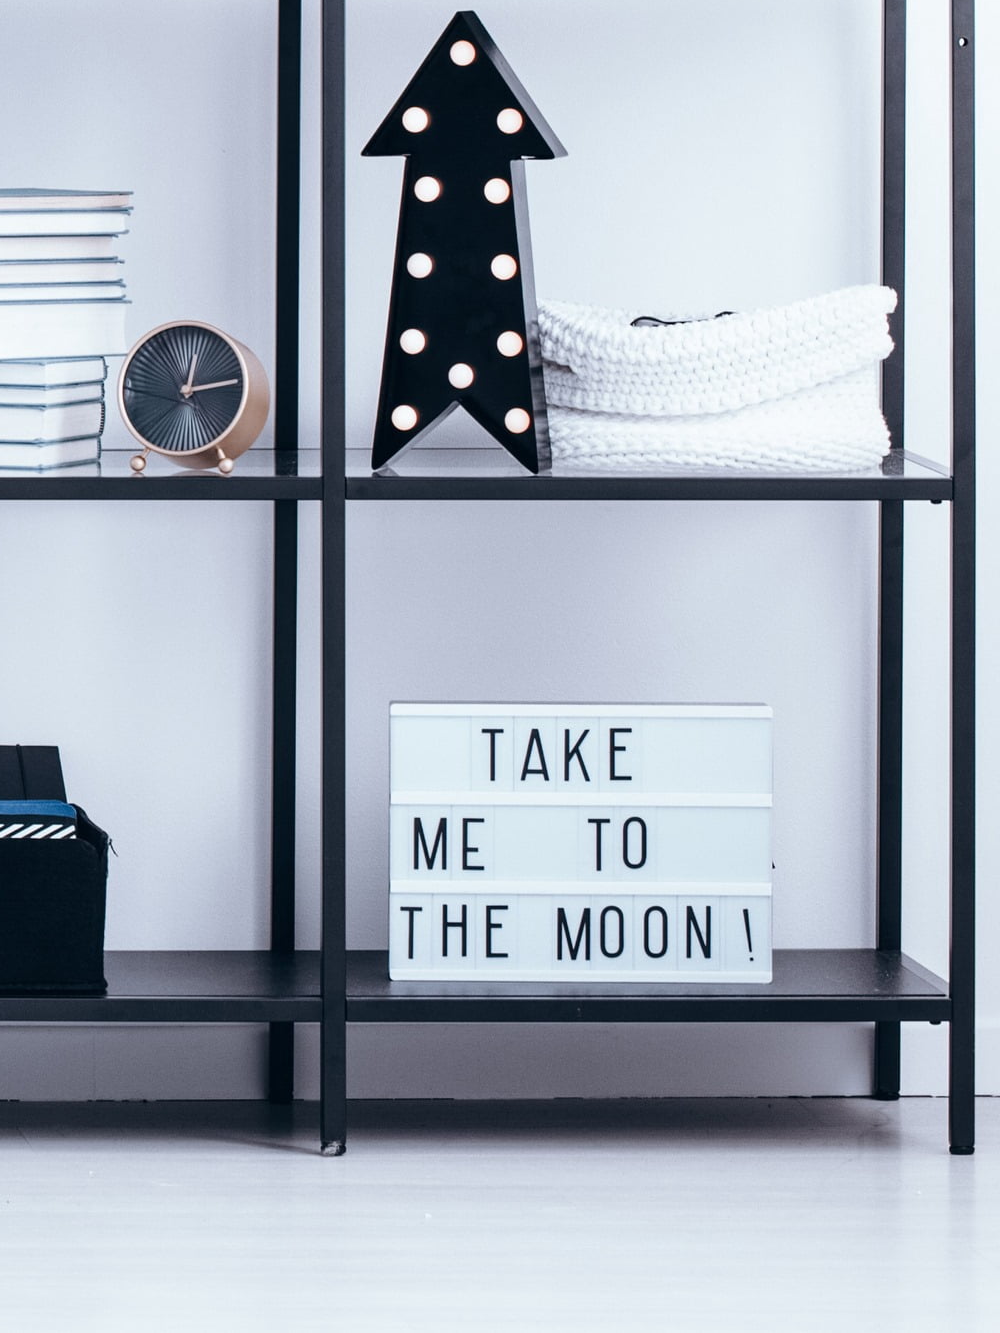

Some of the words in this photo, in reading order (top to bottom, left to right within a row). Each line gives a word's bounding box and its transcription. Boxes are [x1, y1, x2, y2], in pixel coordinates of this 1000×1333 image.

[481, 727, 633, 782] TAKE
[413, 817, 485, 871] ME
[587, 816, 648, 872] TO
[400, 904, 509, 959] THE
[556, 905, 755, 962] MOON!
